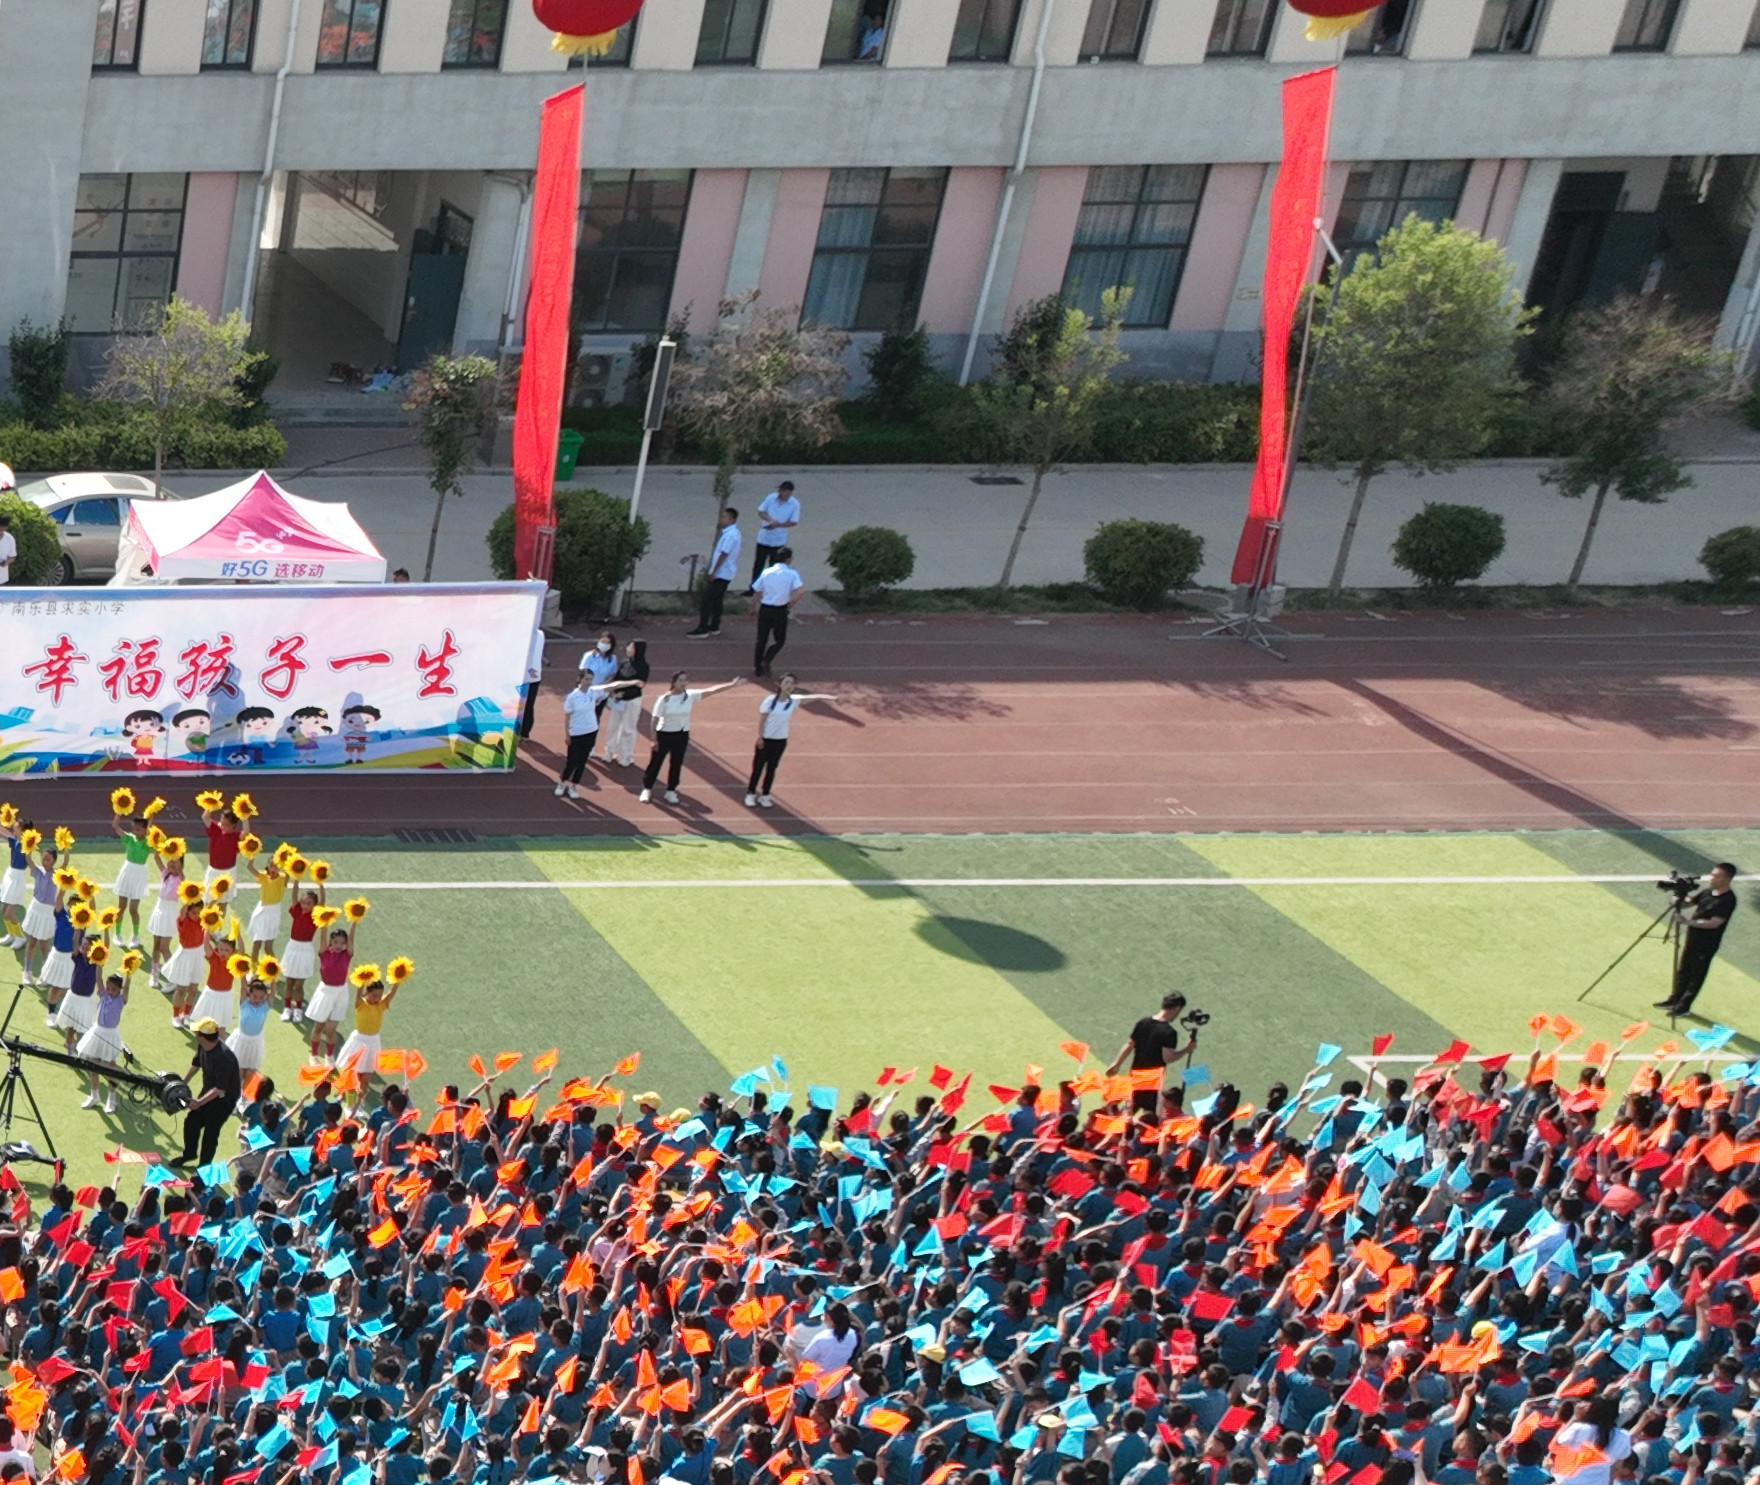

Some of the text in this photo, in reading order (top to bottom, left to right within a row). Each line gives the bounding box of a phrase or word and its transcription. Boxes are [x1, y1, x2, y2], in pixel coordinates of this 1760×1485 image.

[220, 559, 325, 579] 好5G 选移动
[22, 629, 460, 707] 幸福孩子一生
